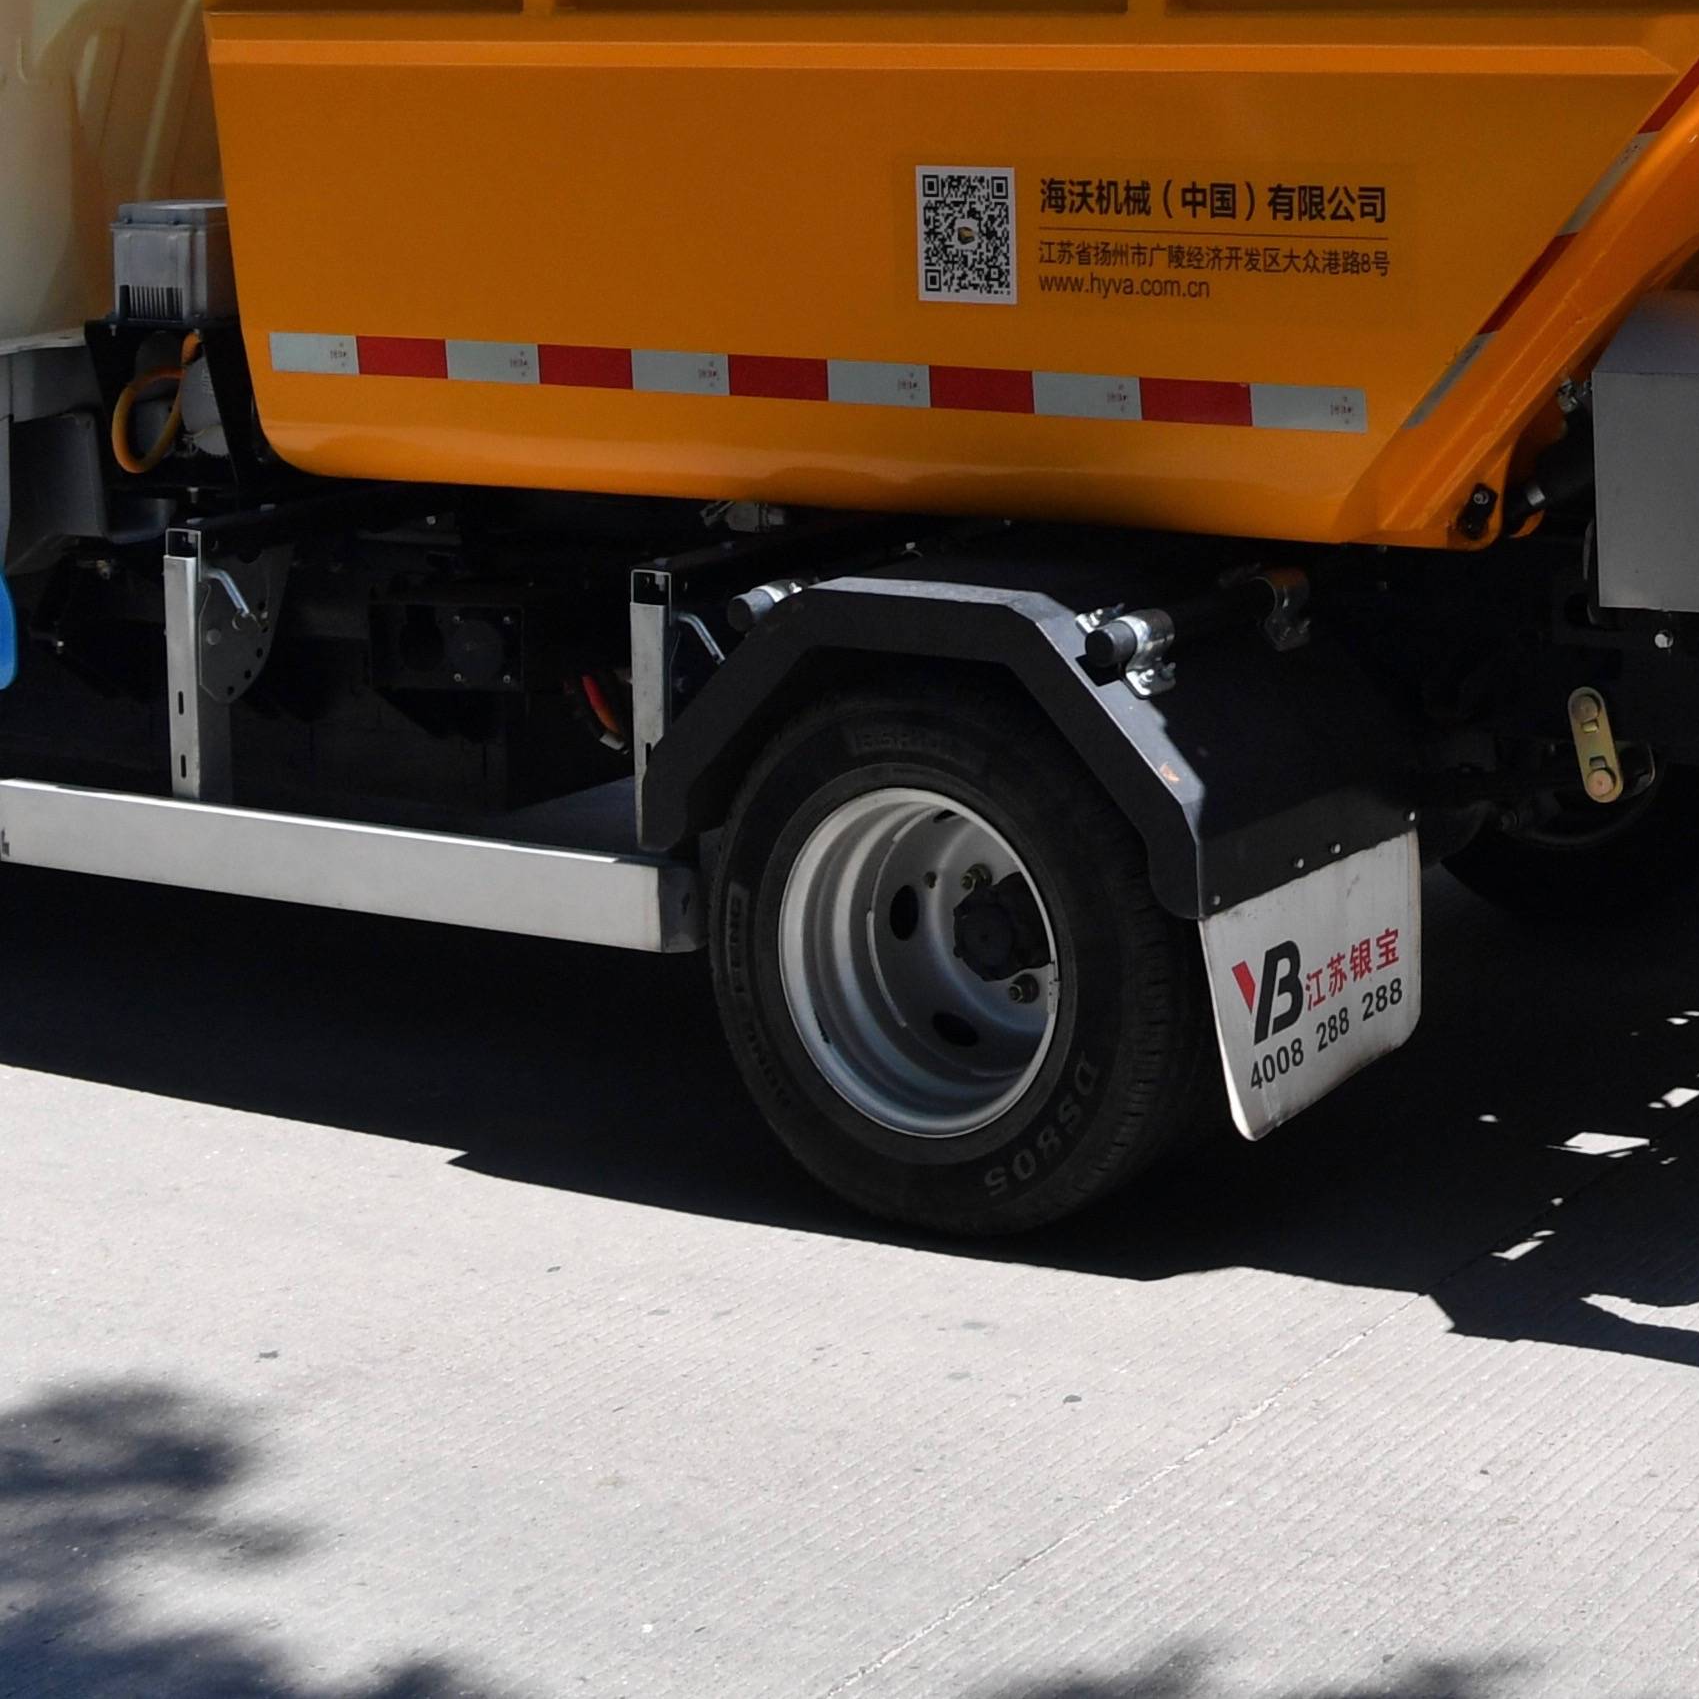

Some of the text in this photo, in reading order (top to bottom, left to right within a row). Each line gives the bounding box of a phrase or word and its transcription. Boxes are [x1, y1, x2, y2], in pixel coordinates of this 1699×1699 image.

[1038, 272, 1211, 300] www.hyva.com.cn
[1304, 927, 1400, 1011] 江苏银宝
[1250, 977, 1403, 1090] 4008 288 288
